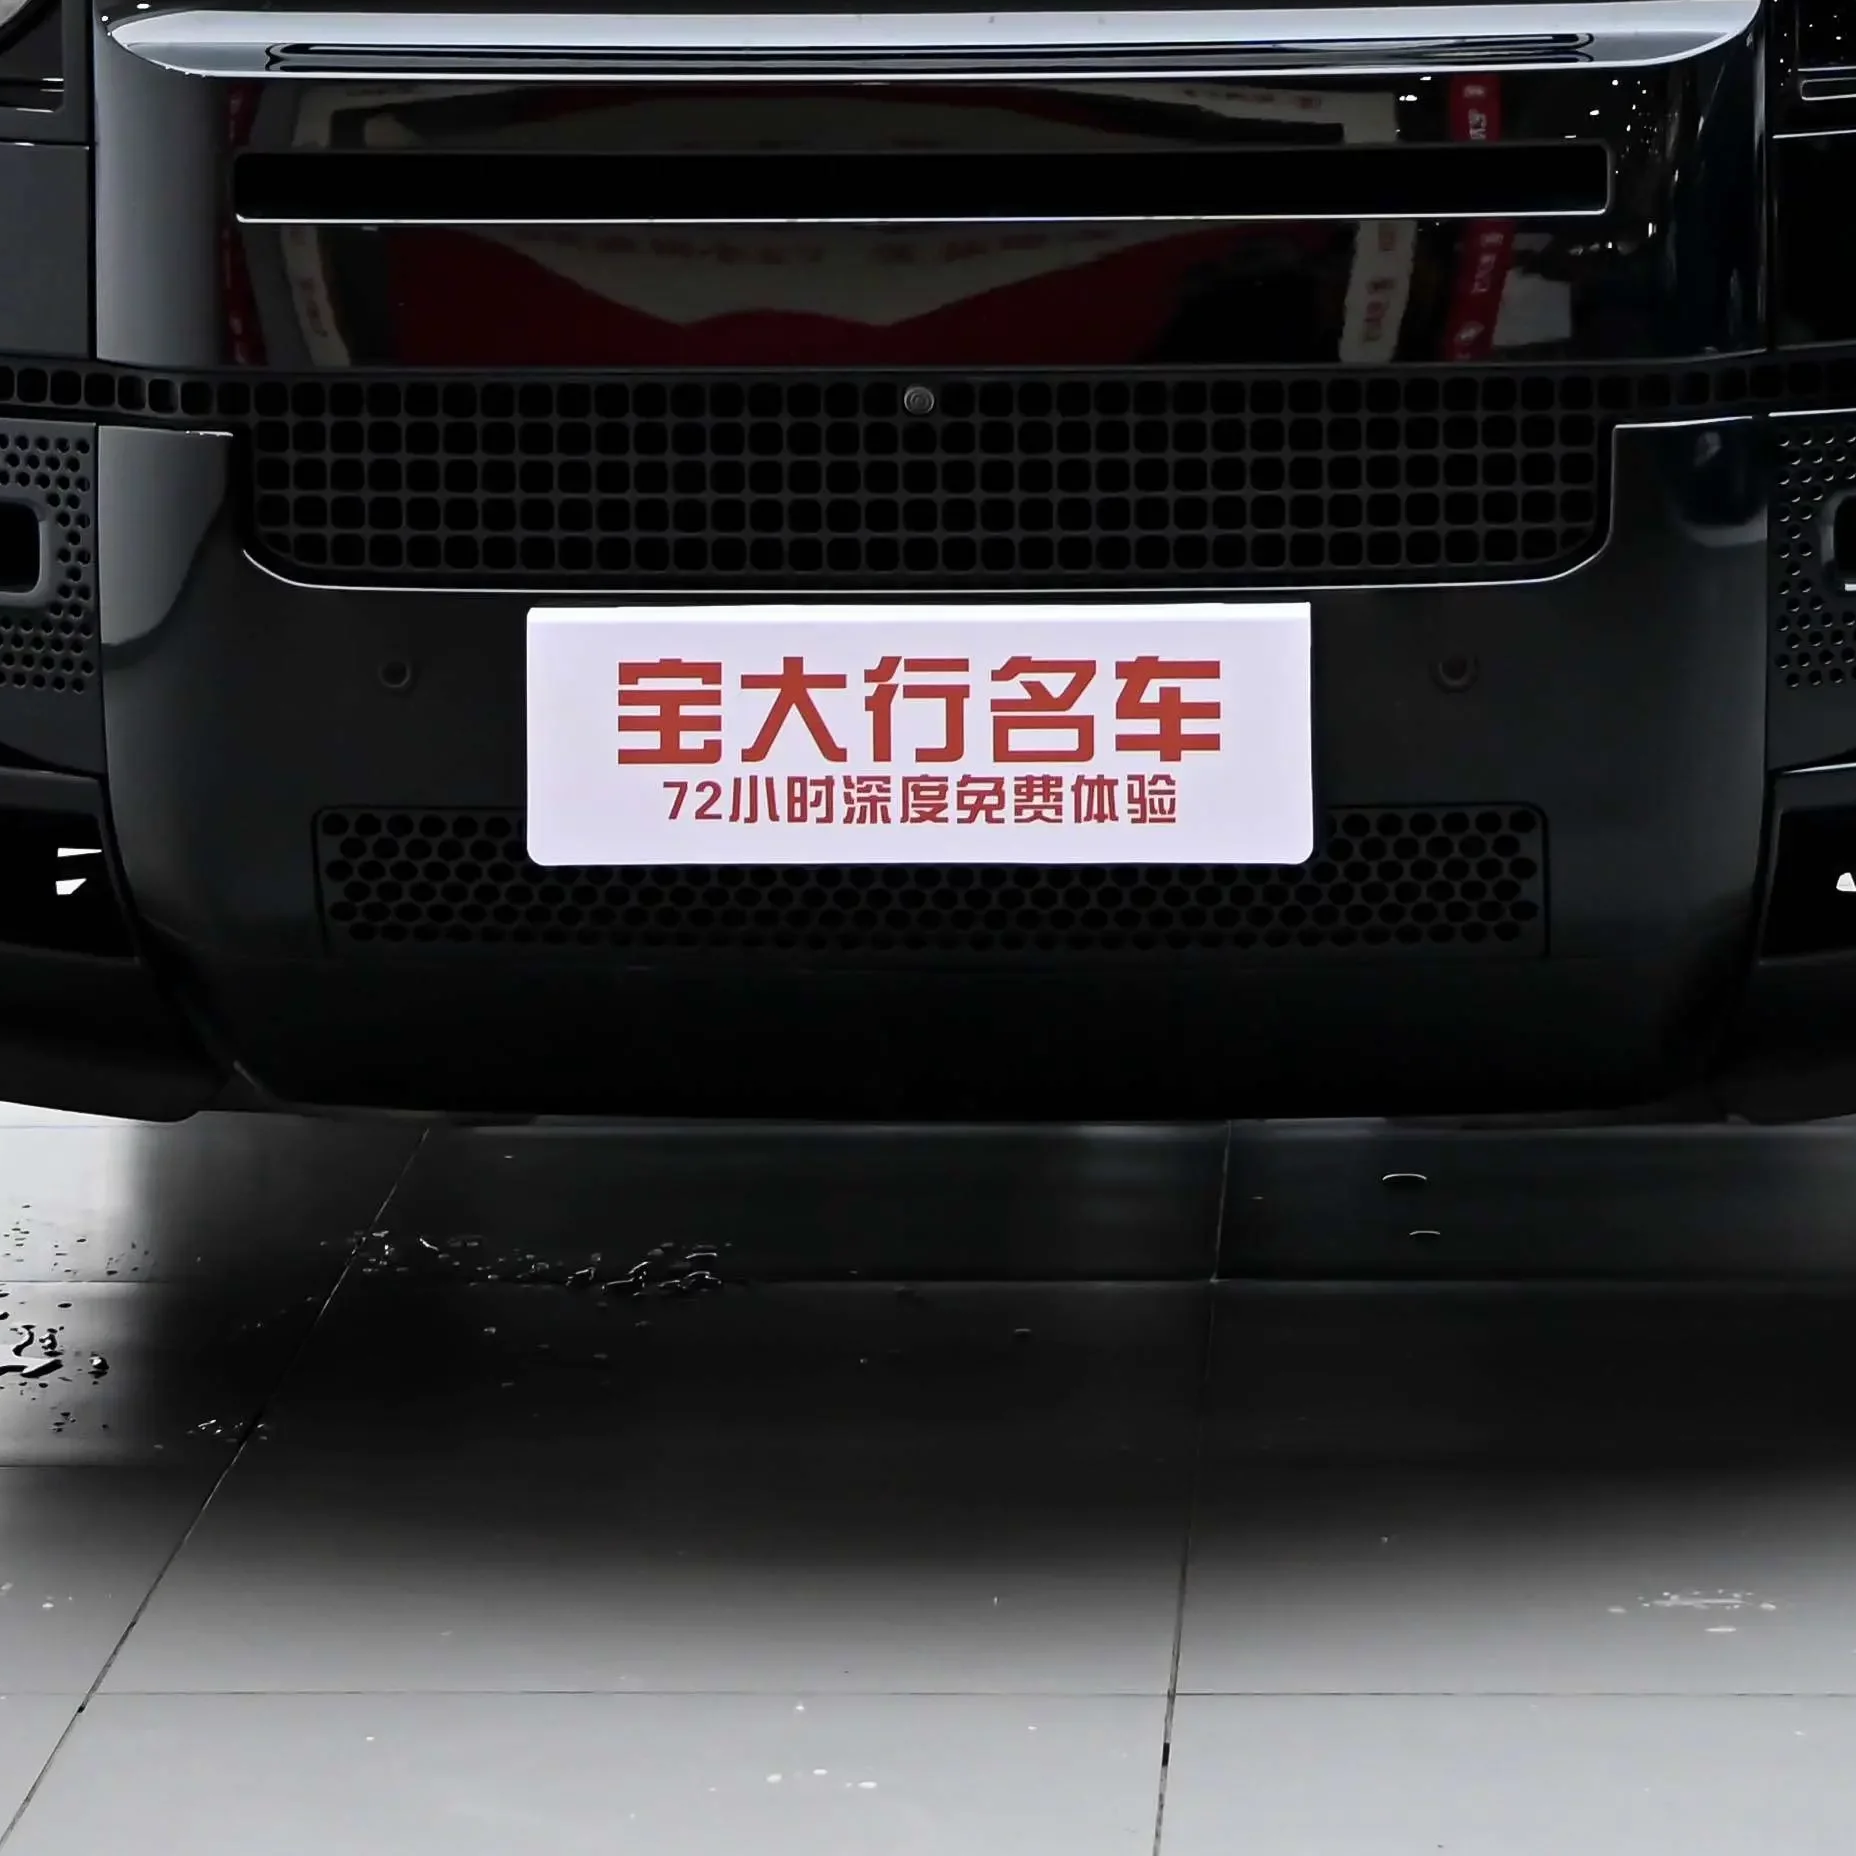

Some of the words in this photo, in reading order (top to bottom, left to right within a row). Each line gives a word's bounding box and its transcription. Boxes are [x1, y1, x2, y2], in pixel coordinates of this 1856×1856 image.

[618, 656, 1221, 764] 宝大行名车
[663, 775, 1177, 825] 72小时深度免费体验
